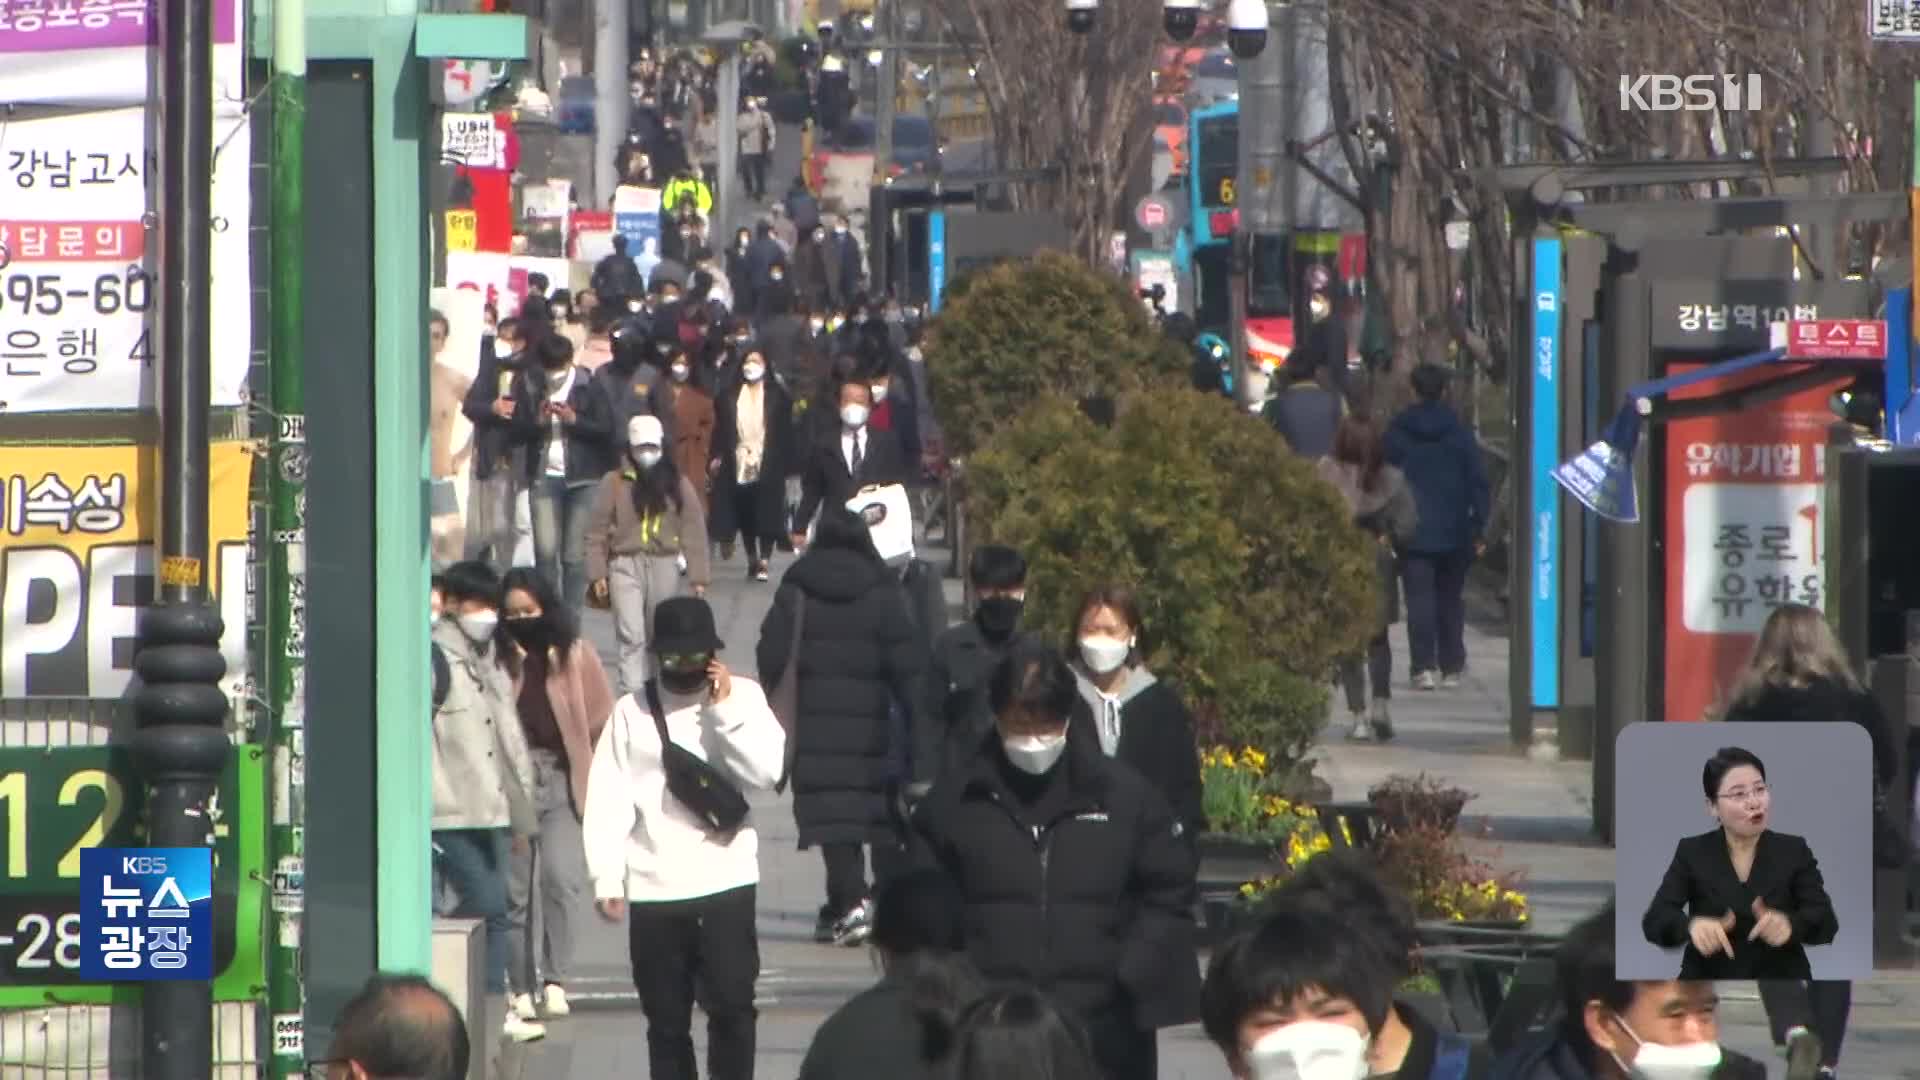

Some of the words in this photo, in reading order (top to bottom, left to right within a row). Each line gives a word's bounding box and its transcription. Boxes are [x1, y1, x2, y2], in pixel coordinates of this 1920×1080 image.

[0, 273, 152, 315] 95-60
[1797, 324, 1880, 347] 토스트
[1686, 442, 1801, 477] 유학기업
